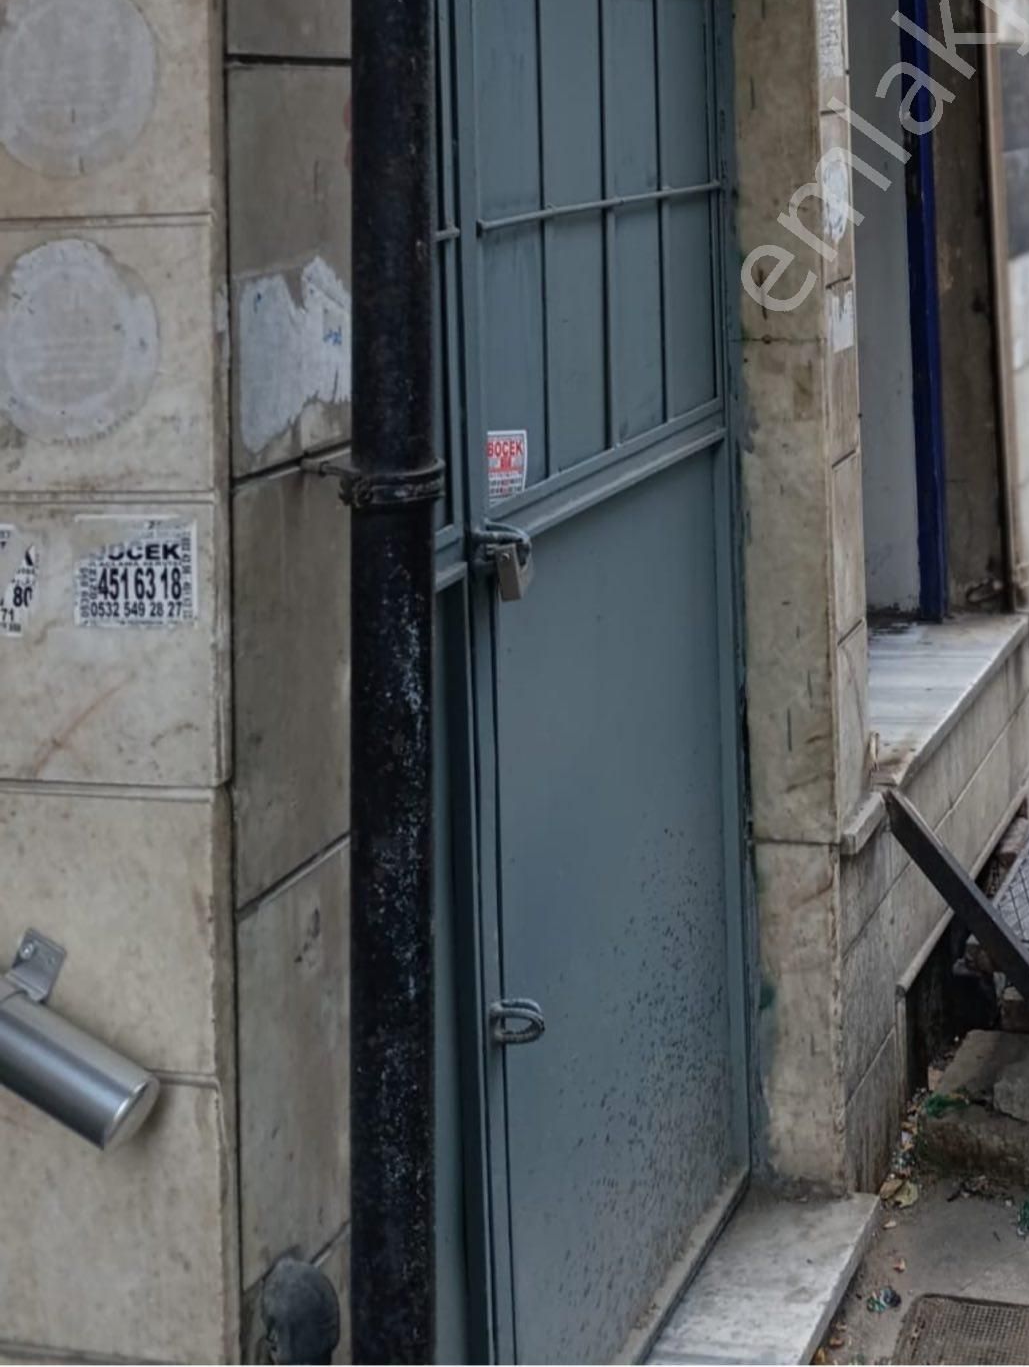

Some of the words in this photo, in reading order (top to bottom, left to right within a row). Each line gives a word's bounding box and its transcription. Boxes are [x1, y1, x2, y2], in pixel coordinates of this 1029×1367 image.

[98, 567, 130, 600] 451
[134, 567, 156, 600] 63
[161, 567, 182, 600] 18
[90, 601, 119, 618] 0532
[124, 601, 145, 618] 549
[150, 601, 164, 618] 28
[167, 601, 183, 618] 27
